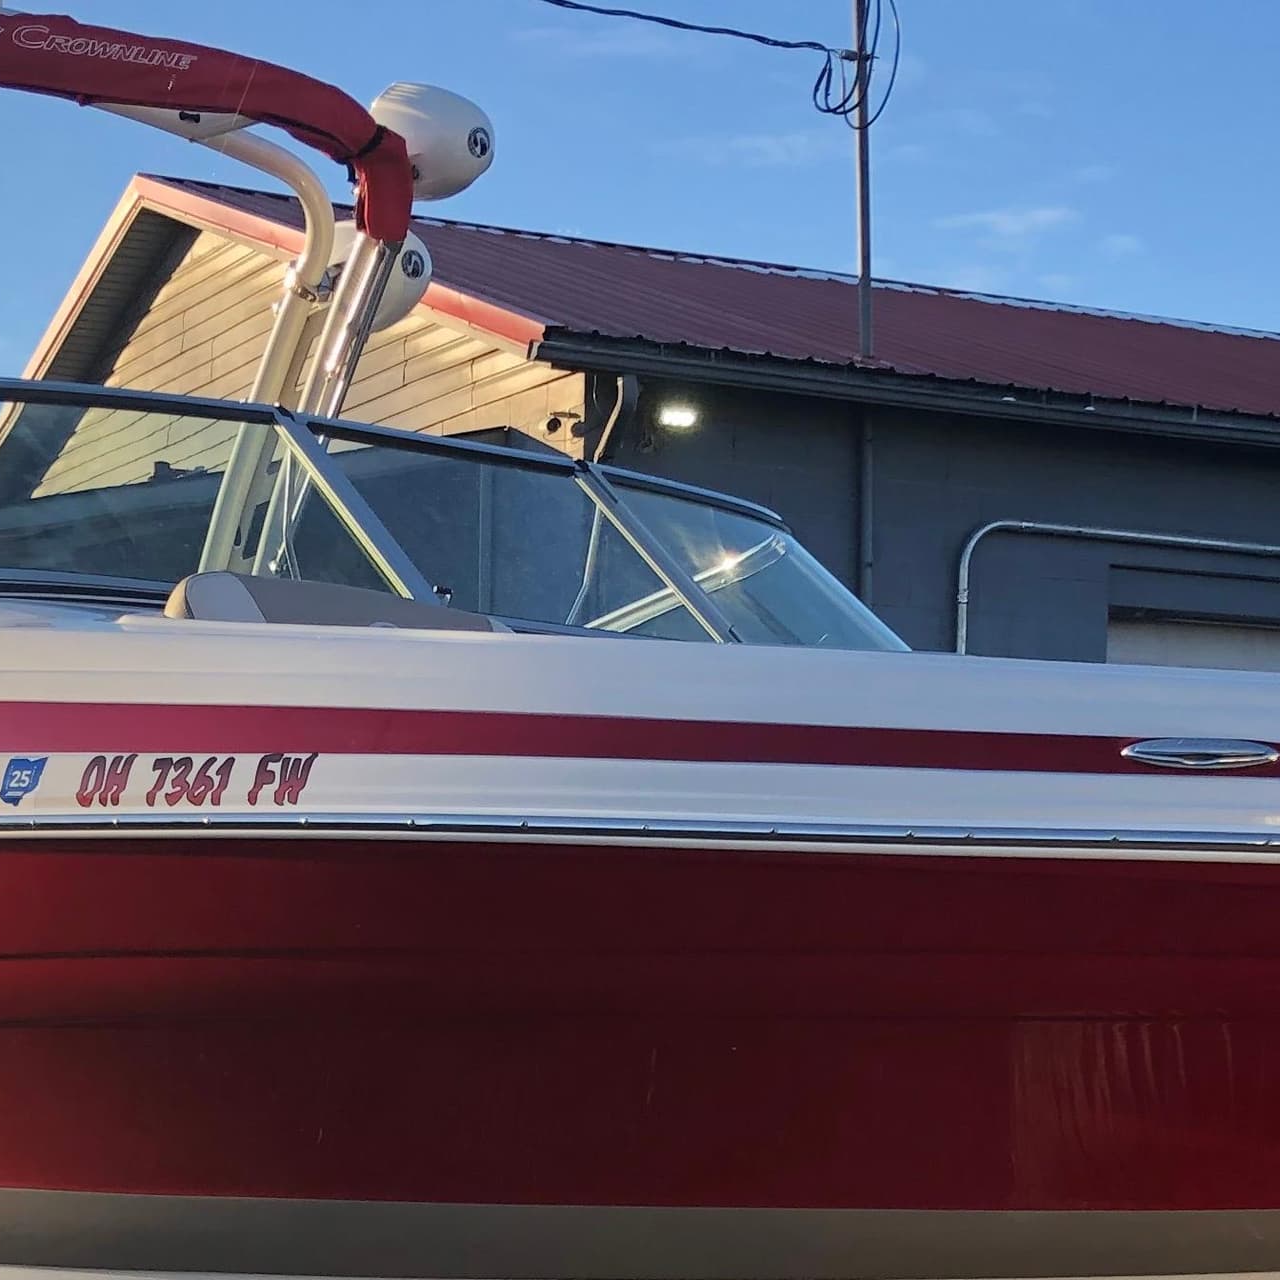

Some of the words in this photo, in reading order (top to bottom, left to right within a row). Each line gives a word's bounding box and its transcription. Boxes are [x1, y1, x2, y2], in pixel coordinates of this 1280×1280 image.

[12, 24, 197, 70] CROWNLINE
[10, 768, 33, 788] 25
[75, 753, 139, 808] OH
[145, 755, 236, 808] 7361
[246, 751, 319, 806] FW
